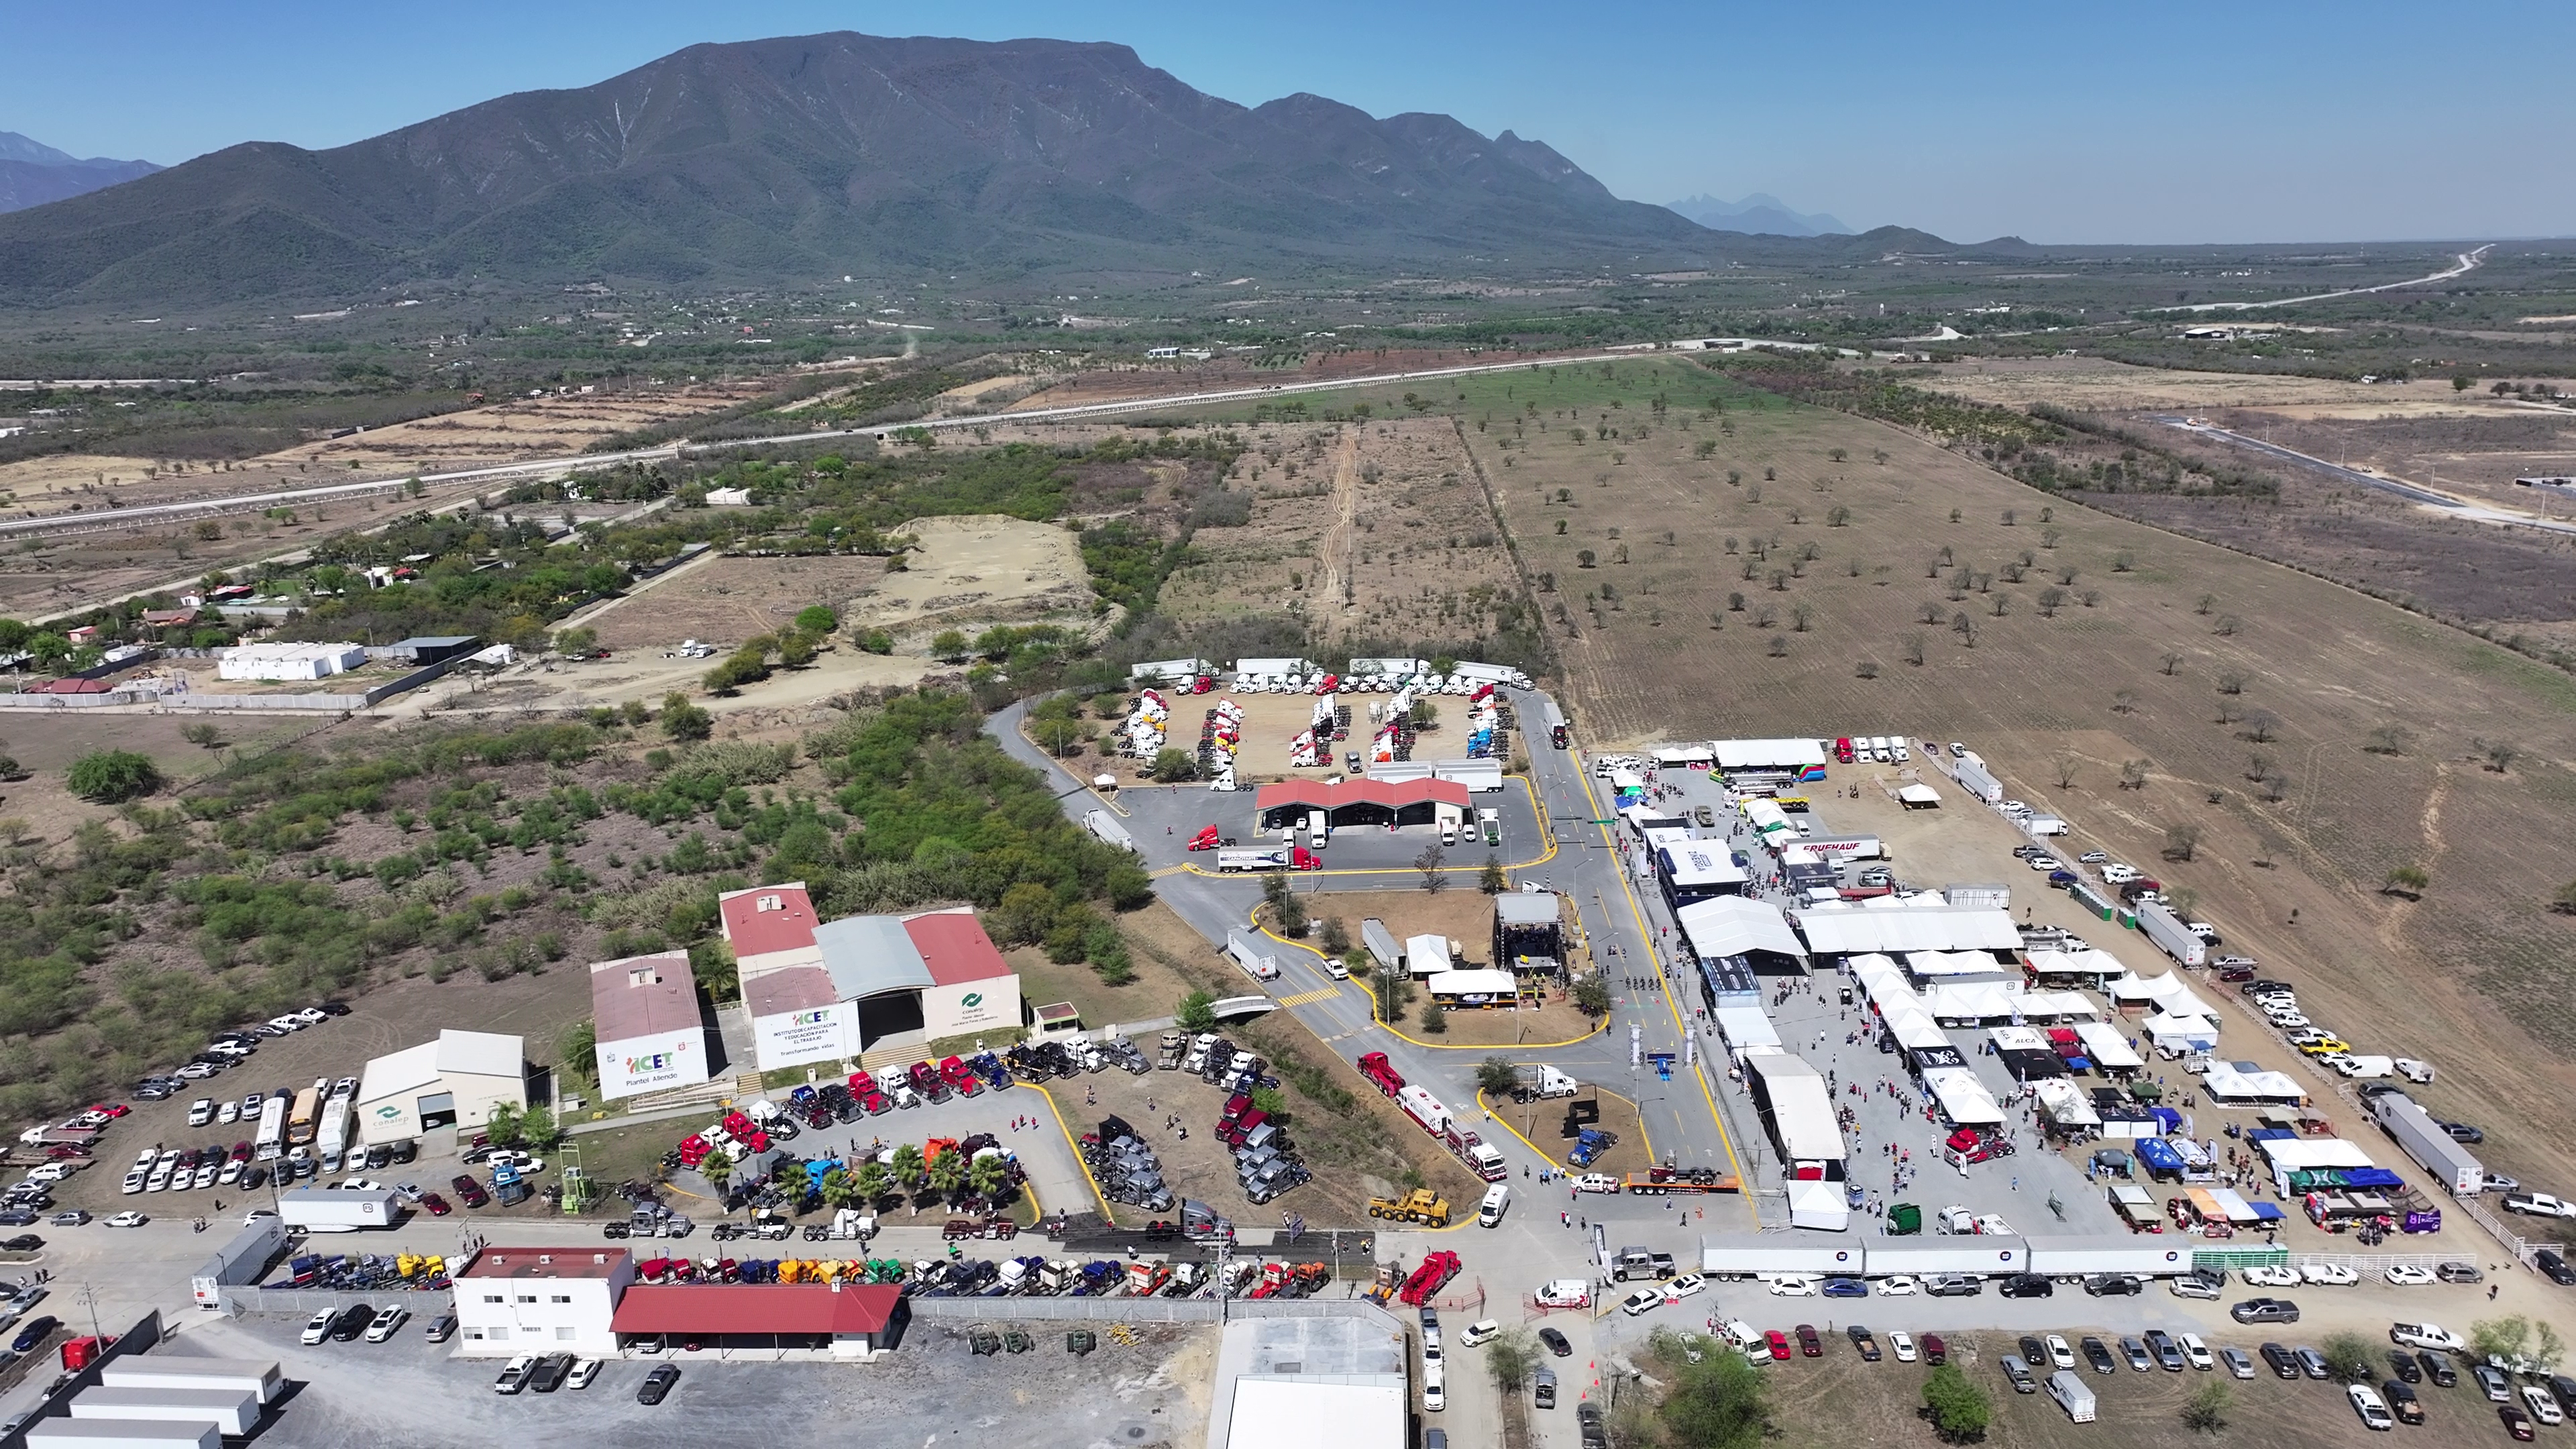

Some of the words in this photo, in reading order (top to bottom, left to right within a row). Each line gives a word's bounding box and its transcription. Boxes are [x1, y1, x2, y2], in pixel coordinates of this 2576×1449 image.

[773, 1028, 797, 1037] INSTITUTO
[800, 1035, 822, 1043] TRABAJO
[780, 1045, 819, 1057] Transformando
[626, 1077, 649, 1087] Plantel
[653, 1073, 678, 1082] Allende
[373, 1116, 409, 1126] conalep
